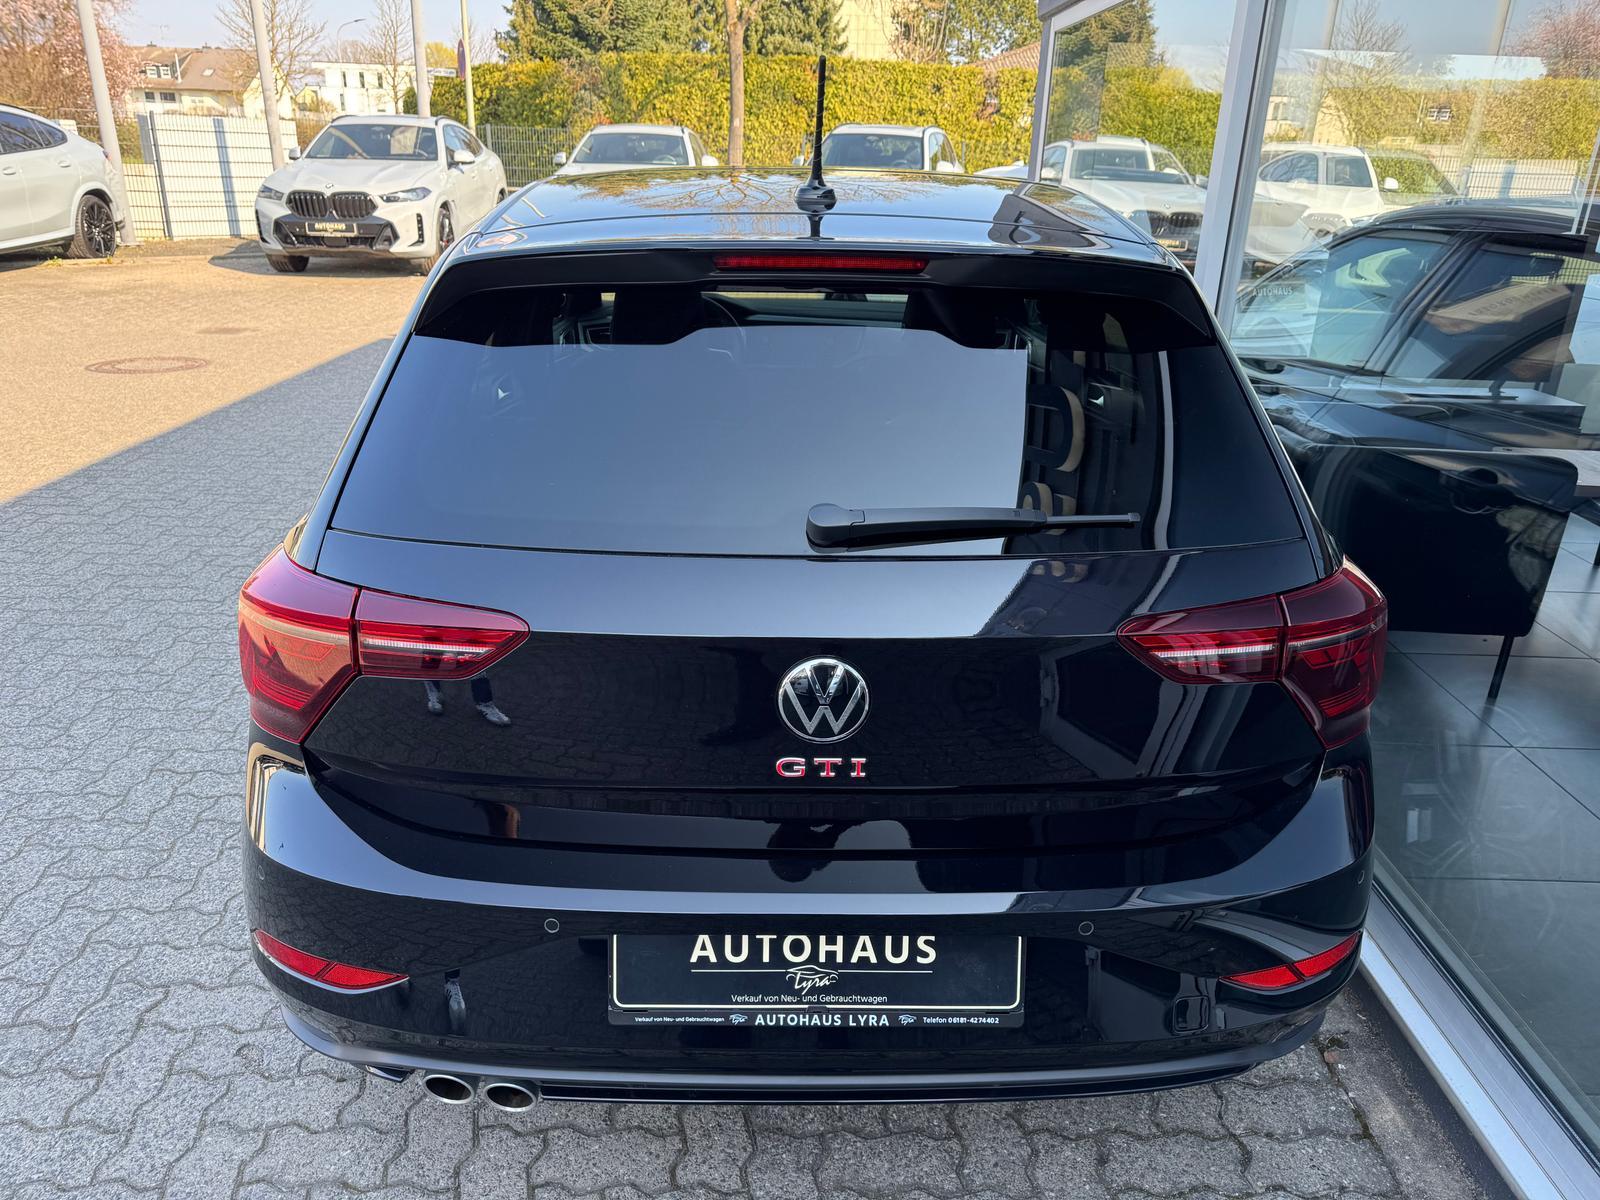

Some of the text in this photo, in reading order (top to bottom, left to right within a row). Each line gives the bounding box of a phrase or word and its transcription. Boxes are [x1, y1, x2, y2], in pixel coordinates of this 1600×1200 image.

[1252, 287, 1293, 297] AUTOHAUS
[776, 757, 867, 777] GTI
[689, 934, 937, 964] AUTOHAUS
[731, 994, 762, 1003] Verkauf
[781, 994, 800, 1003] Neu-
[802, 994, 818, 1003] und
[819, 994, 888, 1005] Gebrauchtwagen
[685, 1016, 725, 1024] Gebrauchtwagen
[754, 1014, 890, 1026] AUTOHAUS LYRA
[922, 1016, 947, 1024] Telefon
